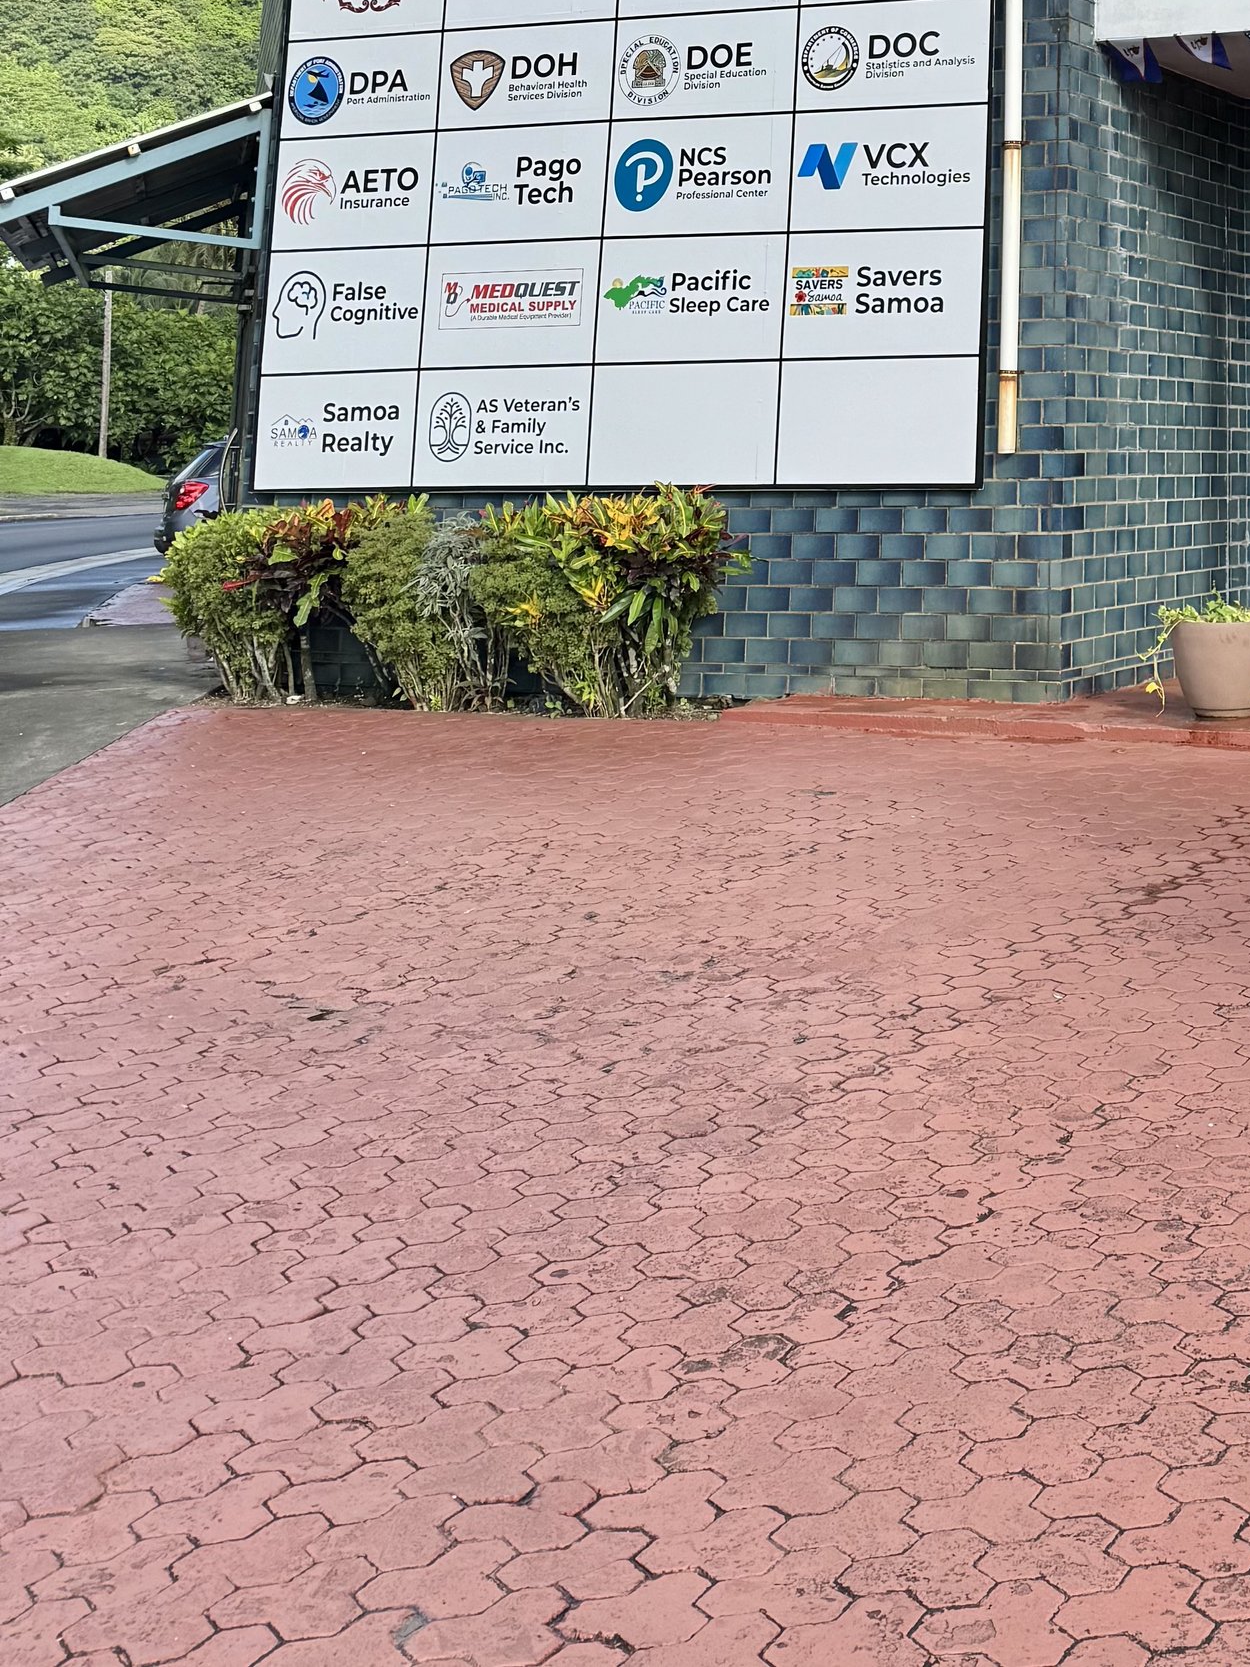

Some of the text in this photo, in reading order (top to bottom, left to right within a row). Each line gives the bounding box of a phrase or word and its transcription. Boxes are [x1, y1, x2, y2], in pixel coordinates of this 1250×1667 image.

[868, 30, 940, 59] DOC
[686, 42, 753, 70] DOE
[865, 55, 976, 70] Statistics and Analysis
[511, 52, 578, 80] DOH
[684, 66, 767, 81] Special Education
[865, 68, 904, 79] Division
[350, 69, 408, 96] DPA
[509, 79, 587, 93] Behavioral Health
[684, 79, 720, 91] Division
[347, 92, 431, 106] Port Administration
[508, 88, 582, 102] Services Division
[627, 89, 670, 105] DIVISION
[680, 146, 727, 167] NCS
[863, 141, 930, 169] VCX
[516, 155, 582, 180] Pago
[340, 166, 419, 194] AETO
[678, 167, 771, 187] Pearson
[862, 170, 971, 188] Technologies
[340, 195, 410, 210] Insurance
[514, 183, 573, 205] Tech
[676, 188, 768, 200] Professional Center
[671, 268, 751, 292] Pacific
[795, 278, 843, 291] SAVERS
[856, 266, 942, 287] Savers
[332, 281, 386, 301] False
[471, 281, 580, 299] MEDQUEST
[807, 289, 843, 303] Samoa
[470, 300, 577, 313] MEDICAL SUPPLY
[629, 300, 665, 309] PACIFIC
[669, 295, 770, 316] Sleep Care
[854, 292, 944, 314] Samoa
[330, 304, 419, 326] Cognitive
[323, 402, 400, 423] Samoa
[476, 396, 580, 413] AS Veteran's
[475, 419, 546, 436] & Family
[321, 432, 394, 456] Realty
[473, 439, 569, 455] Service Inc.
